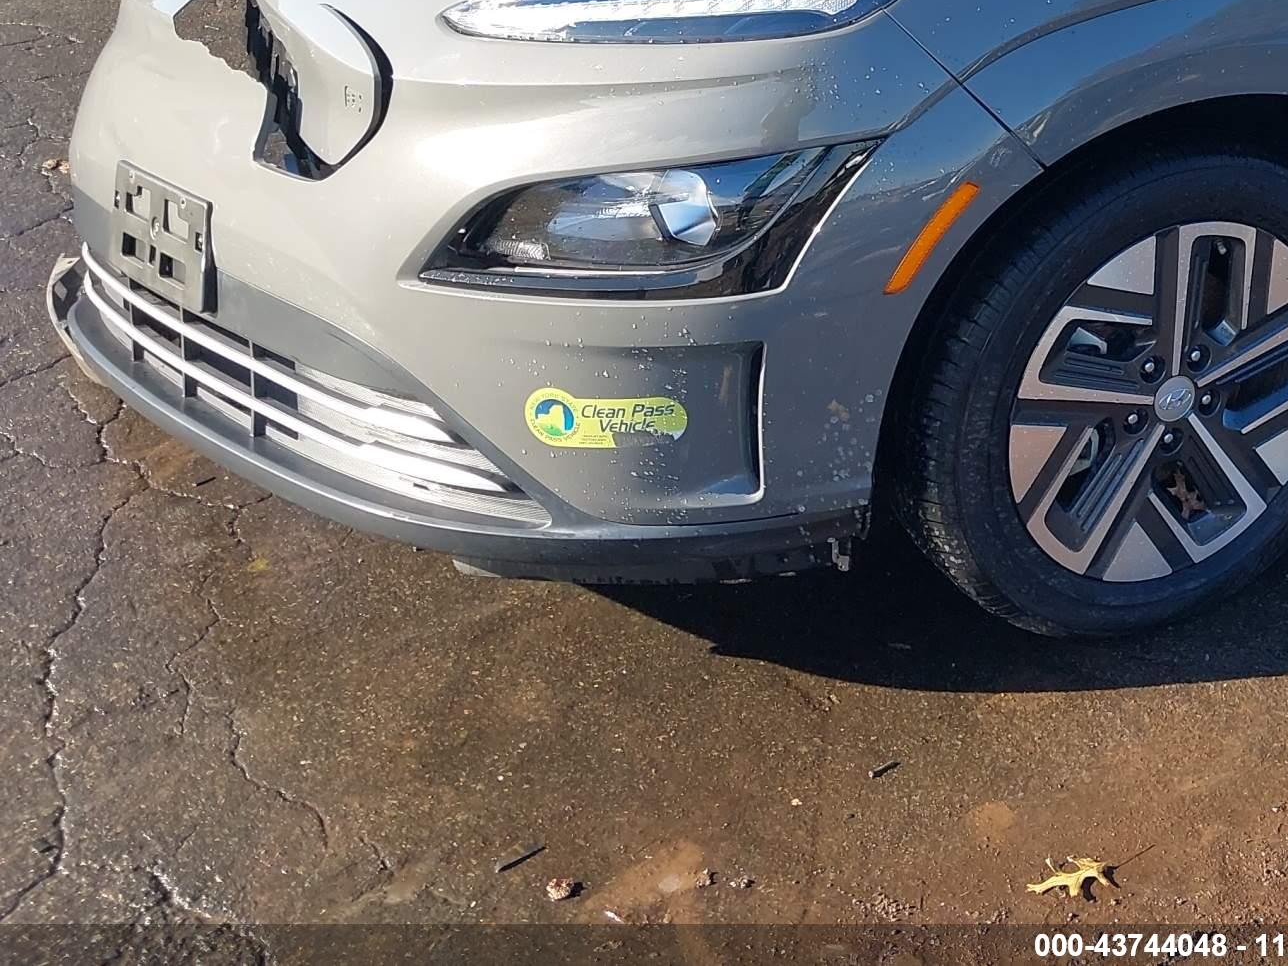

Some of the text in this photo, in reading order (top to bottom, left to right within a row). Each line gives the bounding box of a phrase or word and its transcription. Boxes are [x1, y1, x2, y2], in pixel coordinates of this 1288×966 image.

[581, 404, 676, 419] Clean Pass
[599, 418, 656, 433] Vehicle
